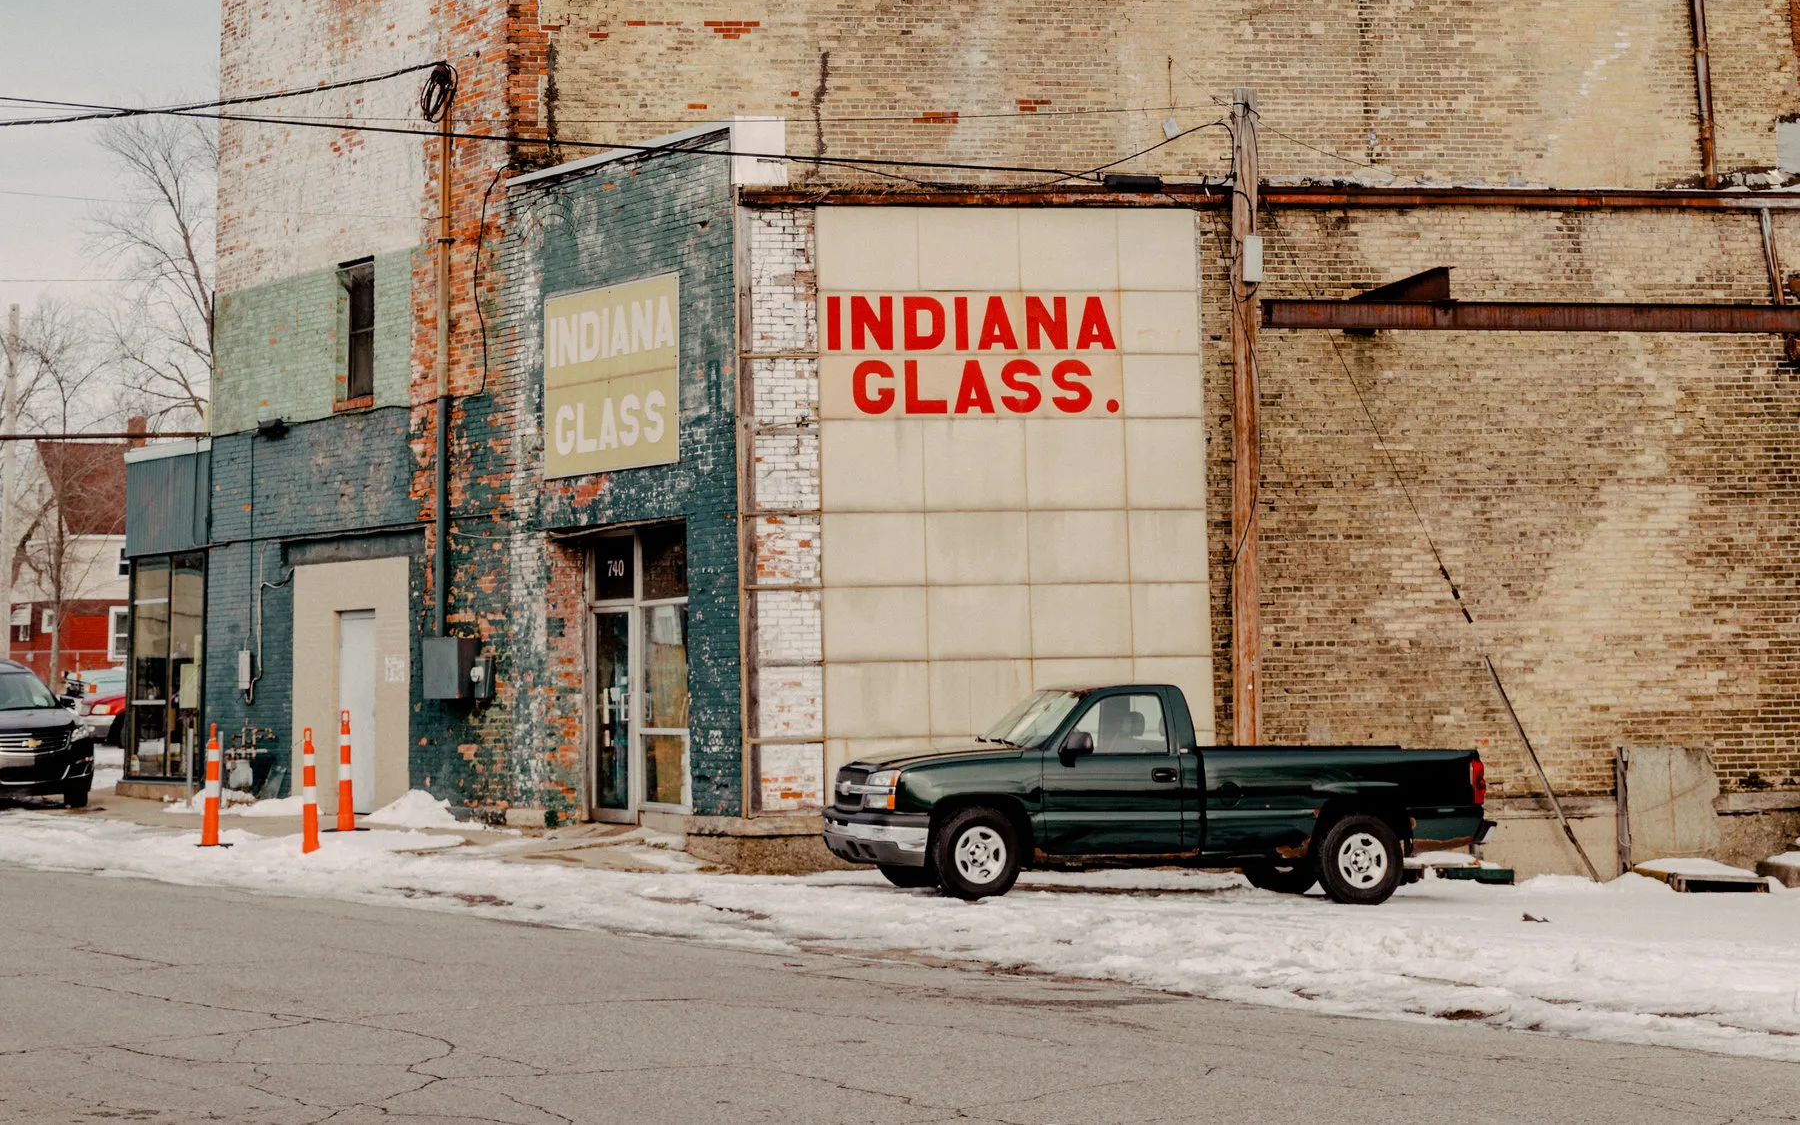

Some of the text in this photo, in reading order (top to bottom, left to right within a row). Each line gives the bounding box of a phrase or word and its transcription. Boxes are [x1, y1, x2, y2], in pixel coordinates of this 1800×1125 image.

[550, 295, 675, 368] INDIANA
[826, 296, 1117, 351] INDIANA
[555, 389, 665, 456] GLASS
[607, 559, 625, 577] 740
